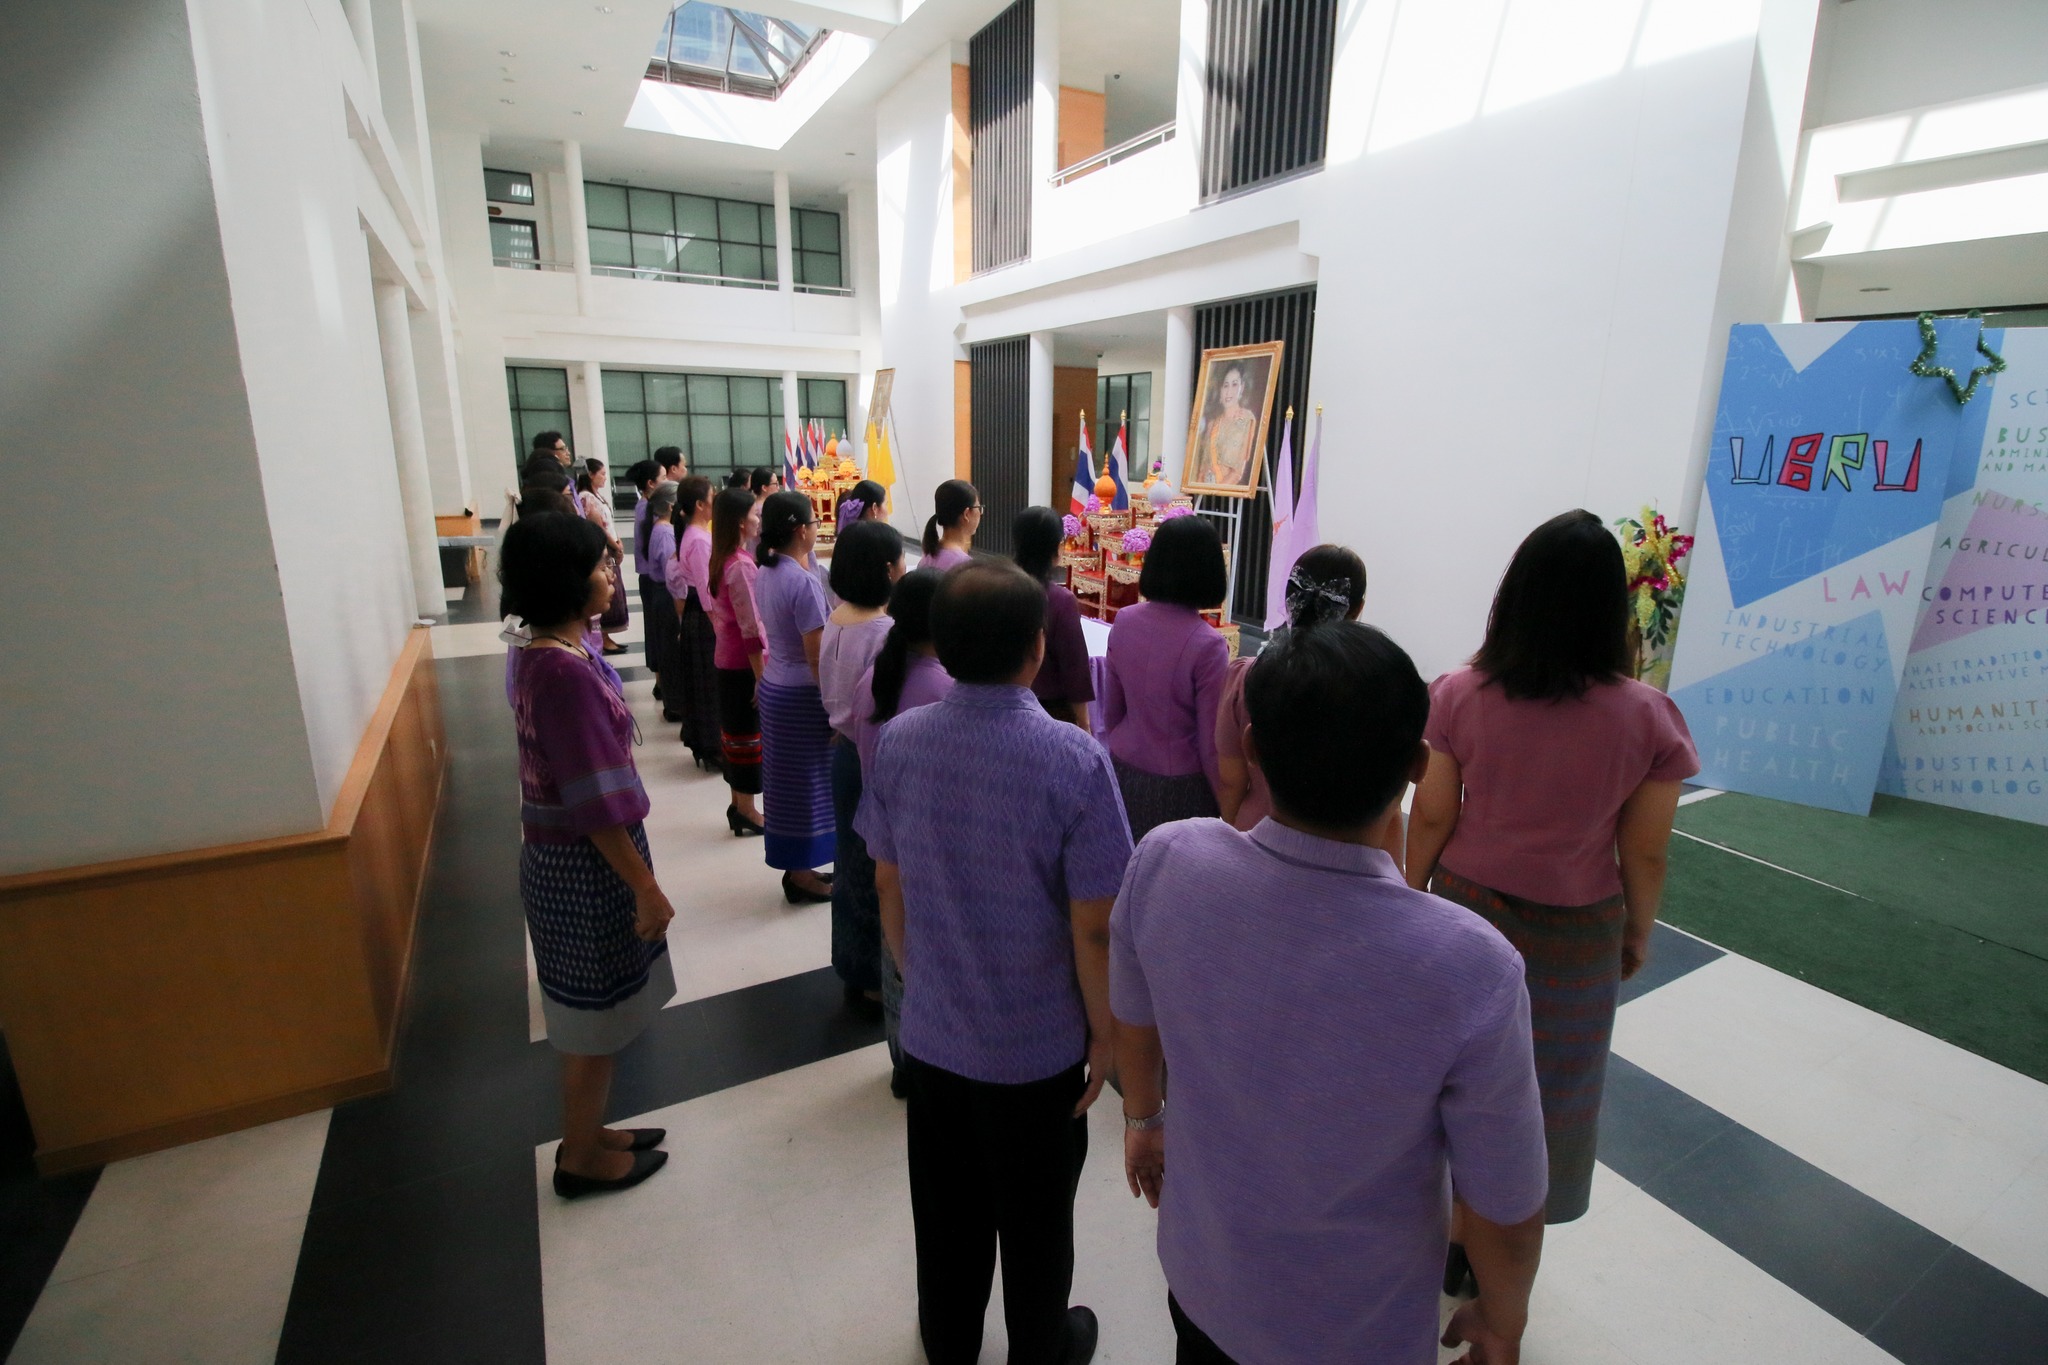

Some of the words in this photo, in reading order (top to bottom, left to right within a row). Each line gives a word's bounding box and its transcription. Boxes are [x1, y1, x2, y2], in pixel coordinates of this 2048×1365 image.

[1729, 432, 1922, 492] UBRU
[1982, 463, 2013, 472] AND
[1823, 570, 1910, 602] LAW
[1725, 609, 1885, 649] INDUSTRIAL
[1720, 631, 1888, 672] TECHNOLOGY
[1909, 667, 2028, 690] ALTERNATIVE
[1706, 688, 1874, 705] EDUCATION
[1909, 700, 2048, 723] HUMANIT
[1716, 716, 1850, 750] PUBLIC
[1918, 726, 1946, 736] AND
[1956, 723, 2014, 733] SOCIAL
[1715, 748, 1850, 786] HEALTH
